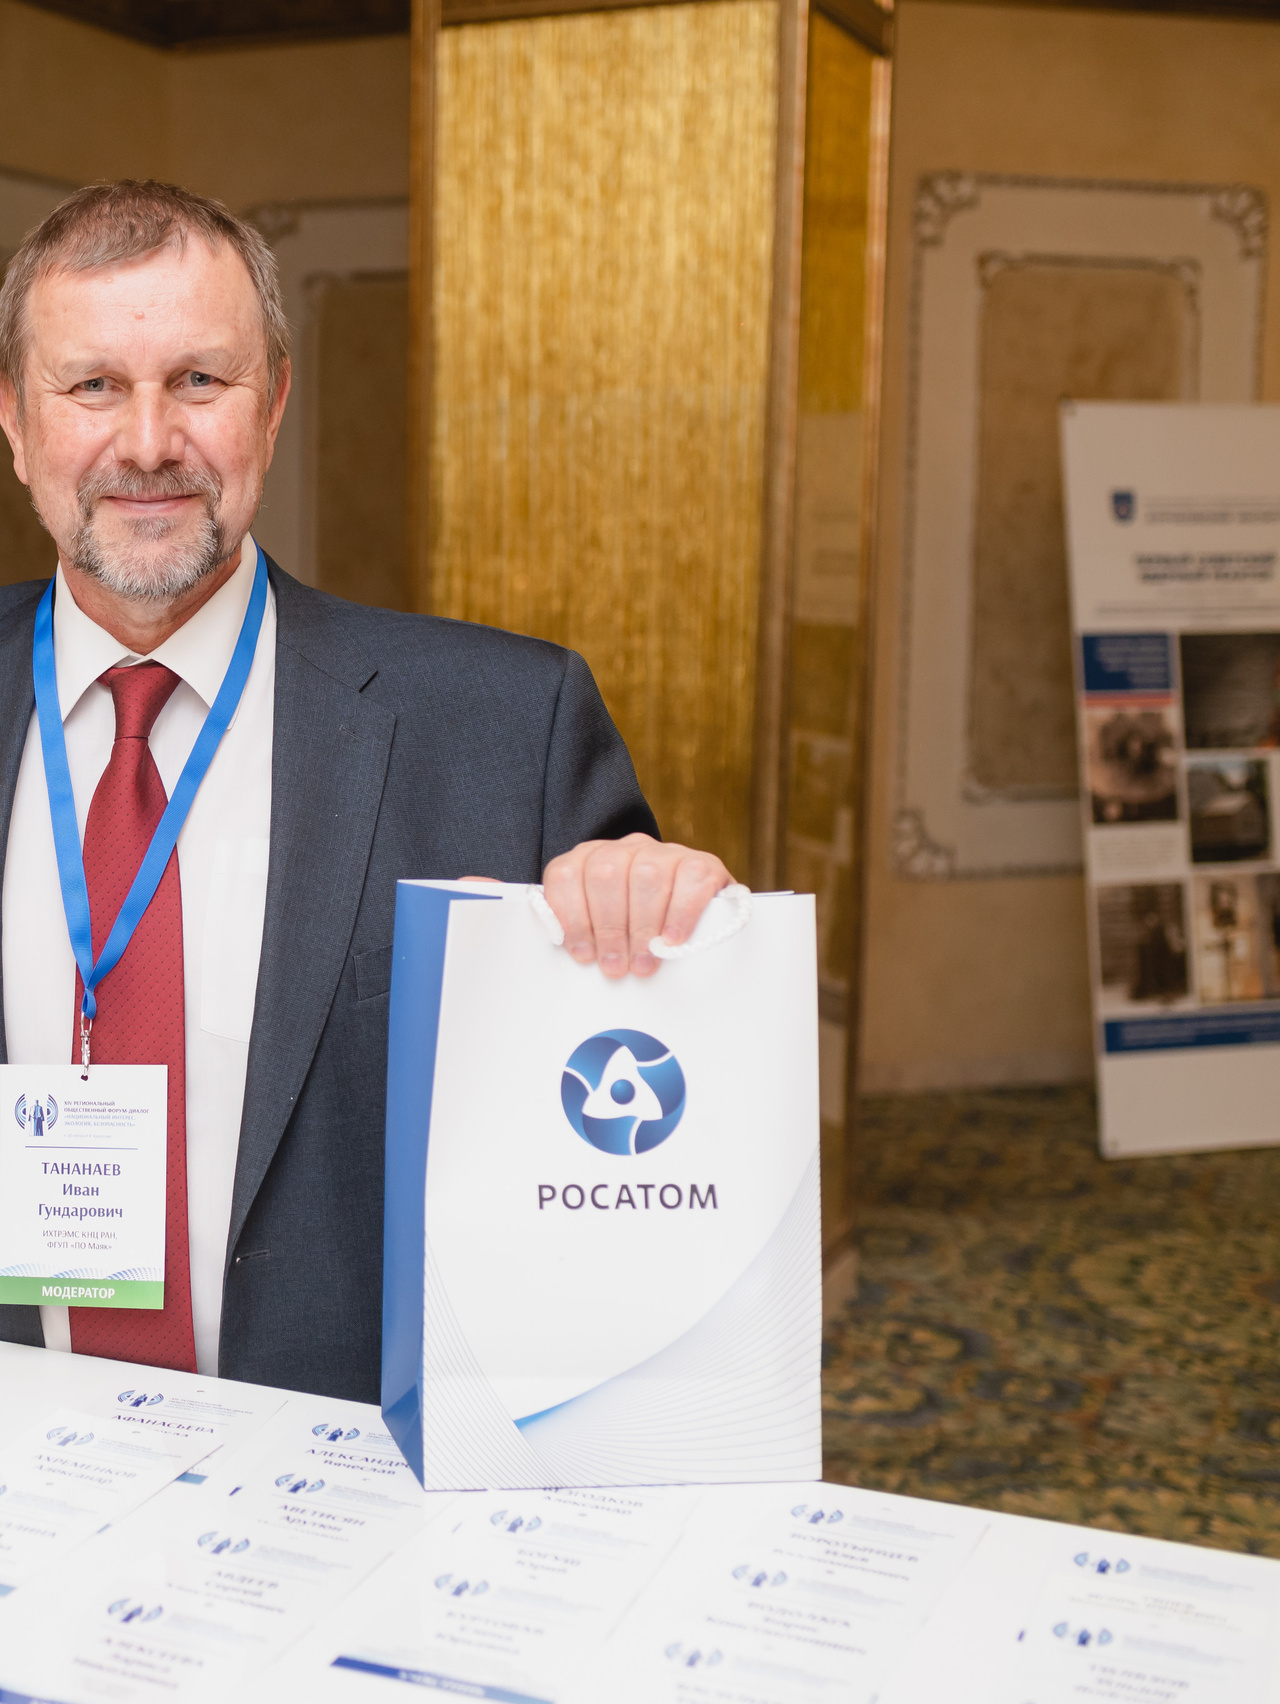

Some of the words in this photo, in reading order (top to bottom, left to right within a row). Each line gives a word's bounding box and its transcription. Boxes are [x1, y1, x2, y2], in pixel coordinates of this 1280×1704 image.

[41, 1162, 121, 1176] ТАНАНАЕВ
[63, 1183, 99, 1196] Иван
[538, 1183, 719, 1210] РОСАТОМ
[38, 1203, 123, 1221] Гундарович
[42, 1230, 80, 1238] ИХТРЭМС
[81, 1231, 99, 1240] КНЦ
[100, 1231, 118, 1240] РАН,
[47, 1241, 68, 1249] ФГУП
[41, 1285, 116, 1300] МОДЕРАТОР
[111, 1414, 215, 1434] АФАНАСЬЕВА
